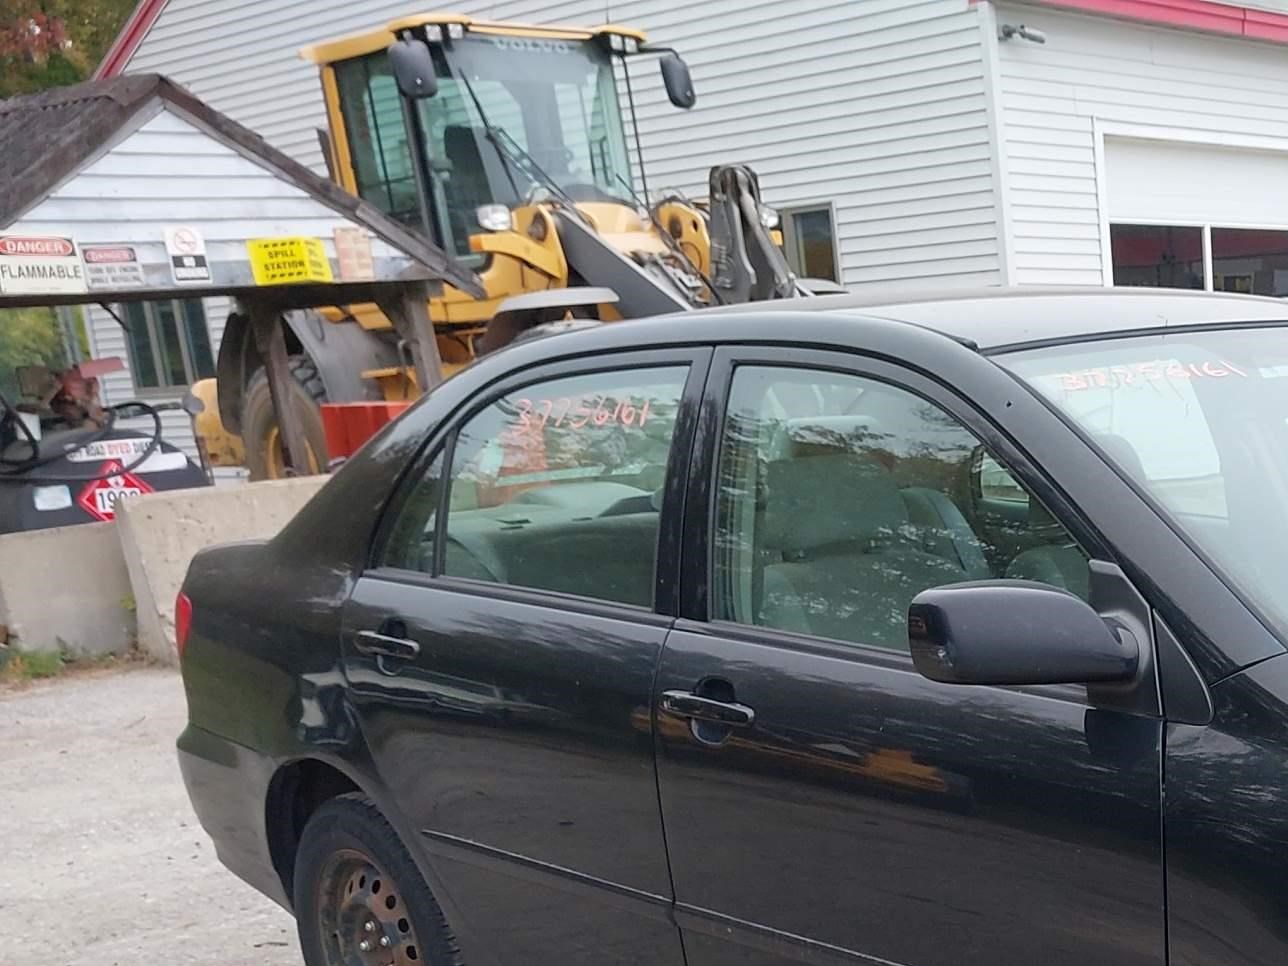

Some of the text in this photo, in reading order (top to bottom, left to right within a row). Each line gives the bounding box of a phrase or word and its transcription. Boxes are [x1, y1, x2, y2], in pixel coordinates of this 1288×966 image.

[496, 37, 569, 54] VOLVO
[6, 239, 64, 256] DANGER
[267, 248, 297, 260] SPILL
[0, 263, 82, 279] FLAMMABLE
[263, 260, 305, 272] STATION
[511, 396, 650, 436] 37756161
